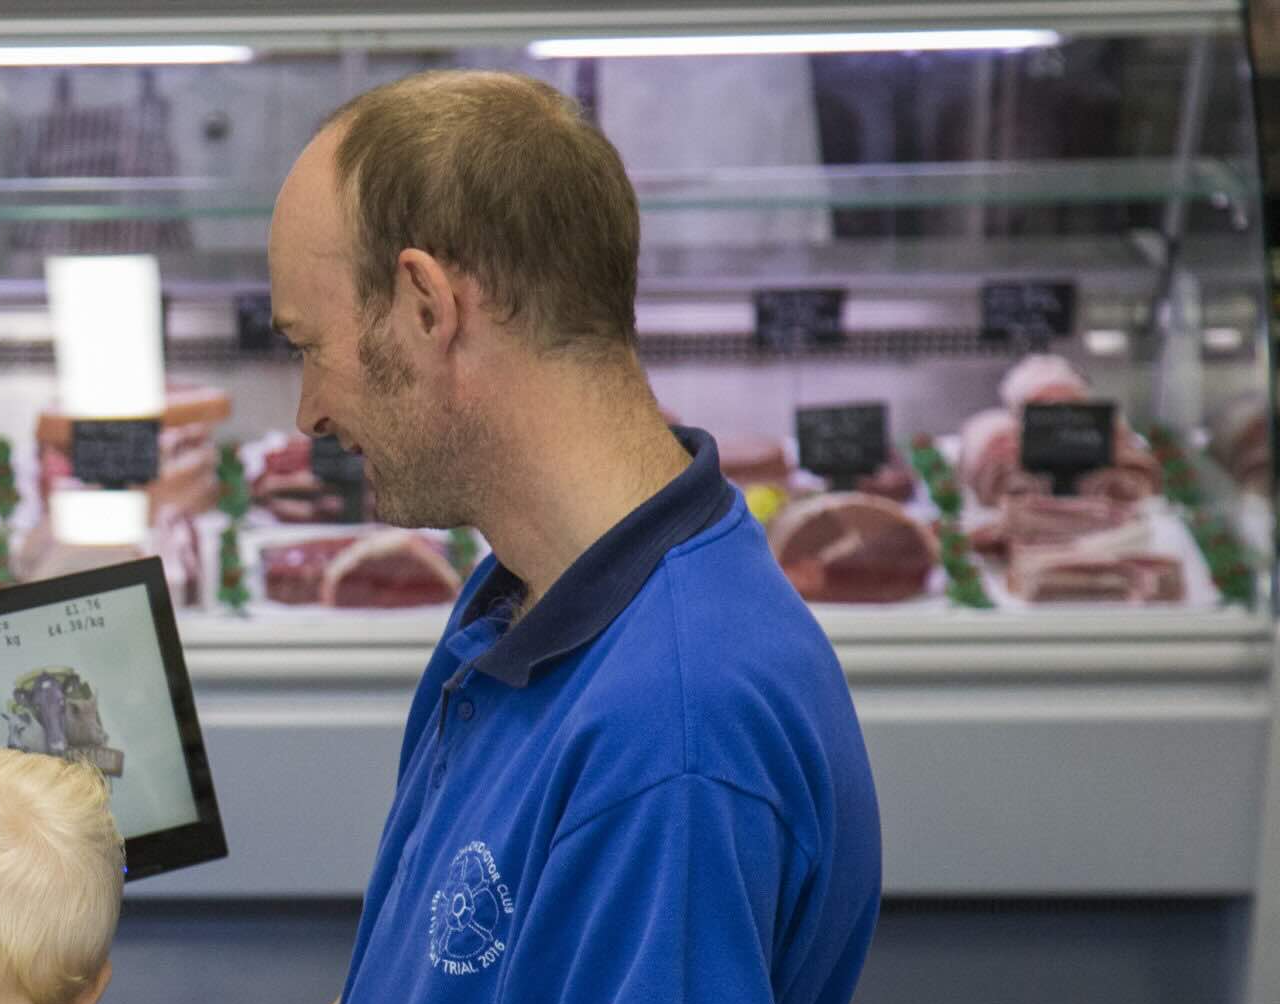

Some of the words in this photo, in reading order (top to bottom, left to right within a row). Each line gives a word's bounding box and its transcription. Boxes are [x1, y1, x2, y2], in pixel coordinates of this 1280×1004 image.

[6, 634, 21, 647] kg
[442, 959, 479, 975] TRIAL
[478, 939, 505, 968] 2016
